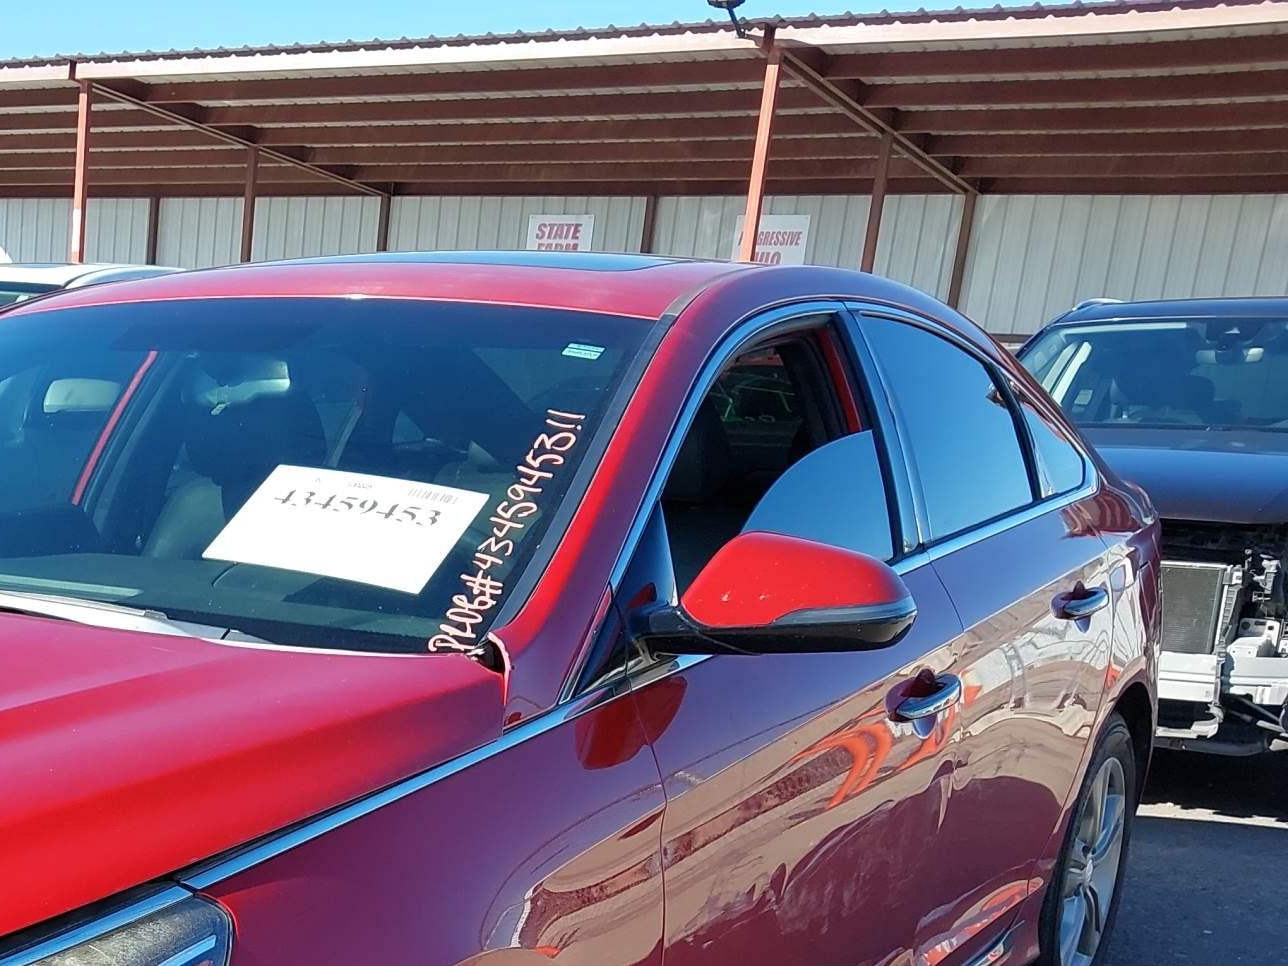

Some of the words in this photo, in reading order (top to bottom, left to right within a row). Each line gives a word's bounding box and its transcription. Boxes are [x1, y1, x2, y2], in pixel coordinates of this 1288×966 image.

[535, 223, 583, 240] STATE
[738, 230, 803, 247] GRESSIVE
[274, 489, 442, 526] 43459453
